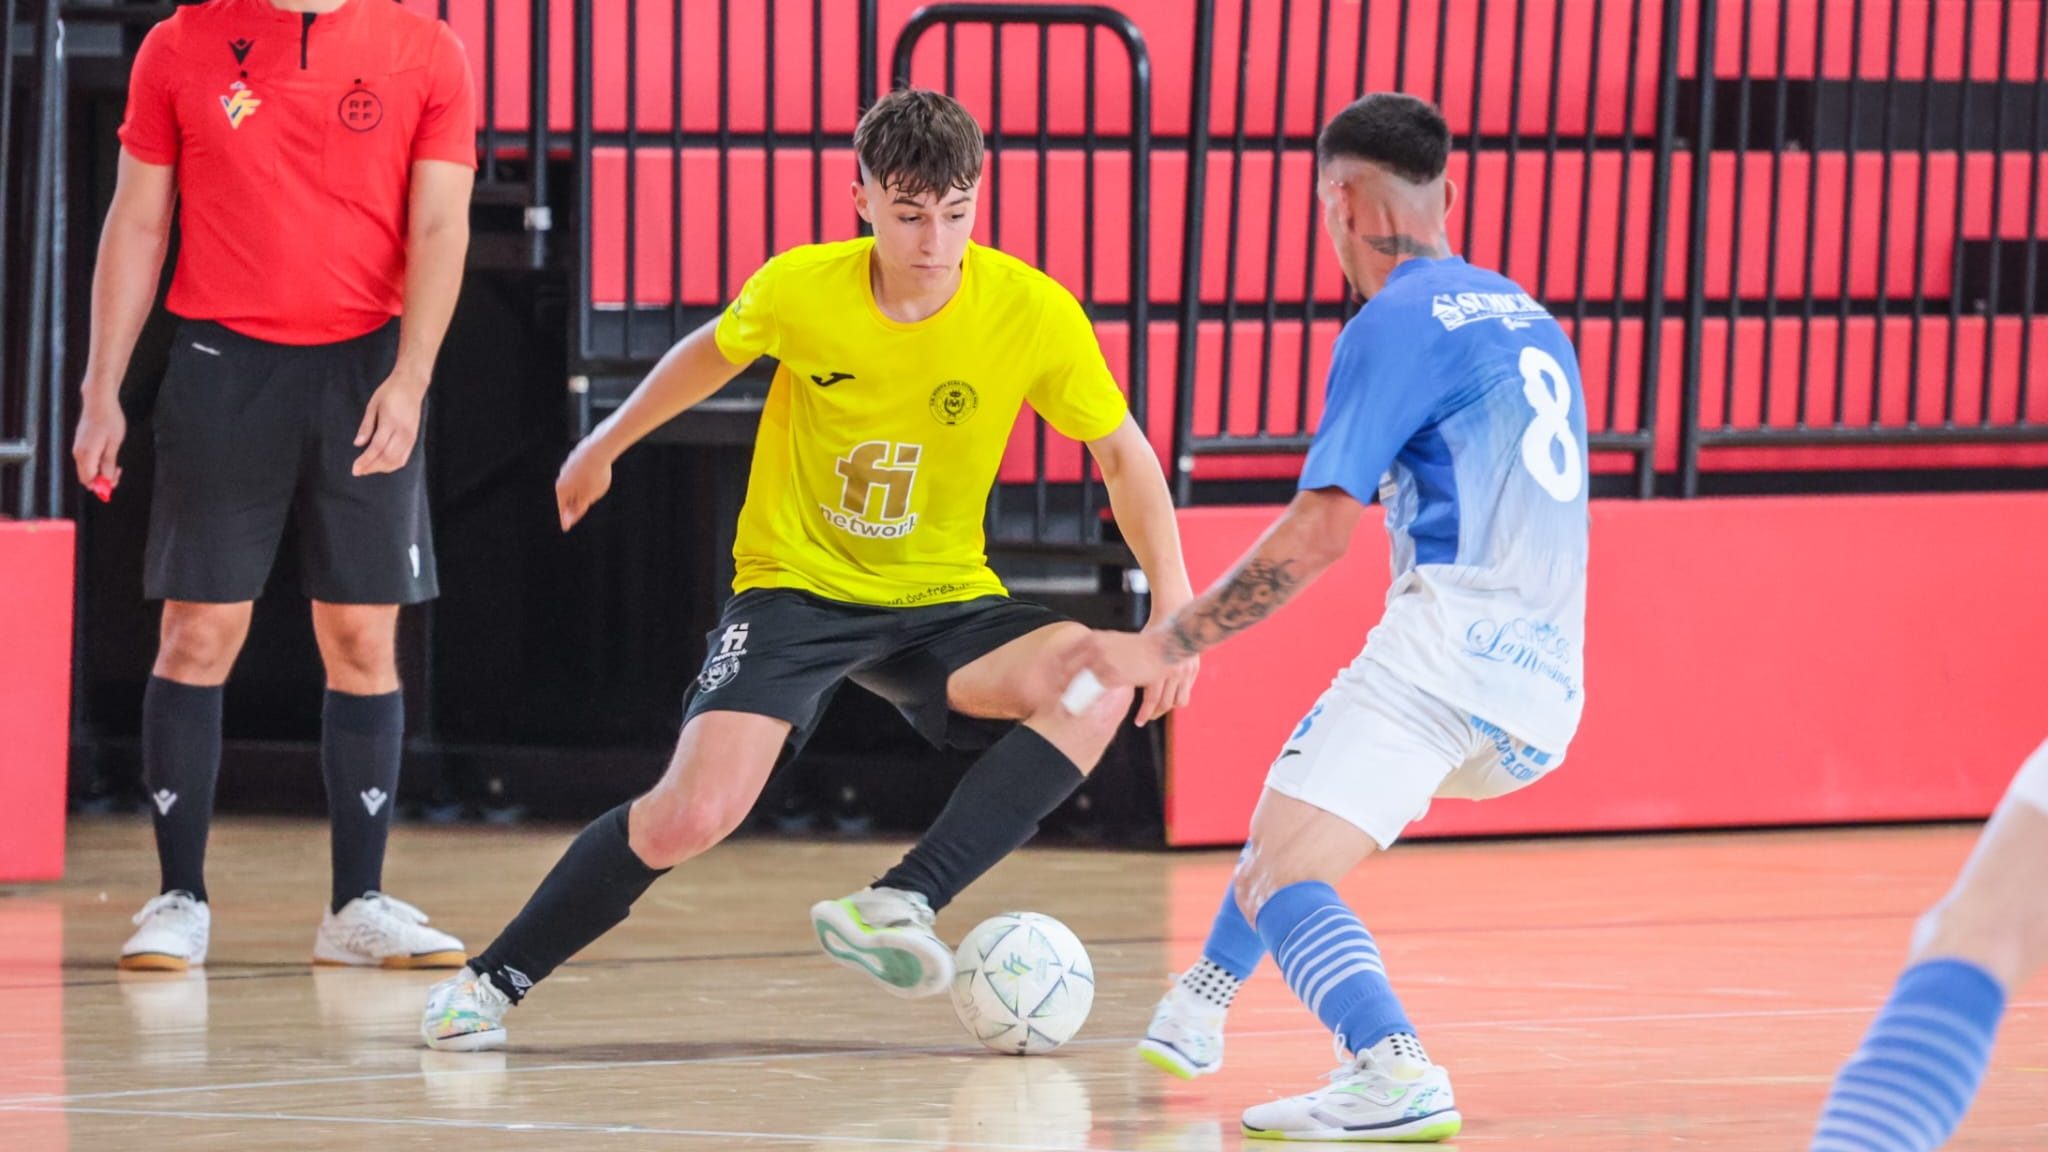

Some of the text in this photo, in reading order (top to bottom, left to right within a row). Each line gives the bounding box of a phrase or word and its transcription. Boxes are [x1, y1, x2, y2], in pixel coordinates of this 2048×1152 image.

[1518, 346, 1582, 503] 8
[835, 440, 922, 521] fi
[819, 504, 918, 539] network
[721, 622, 749, 654] fi
